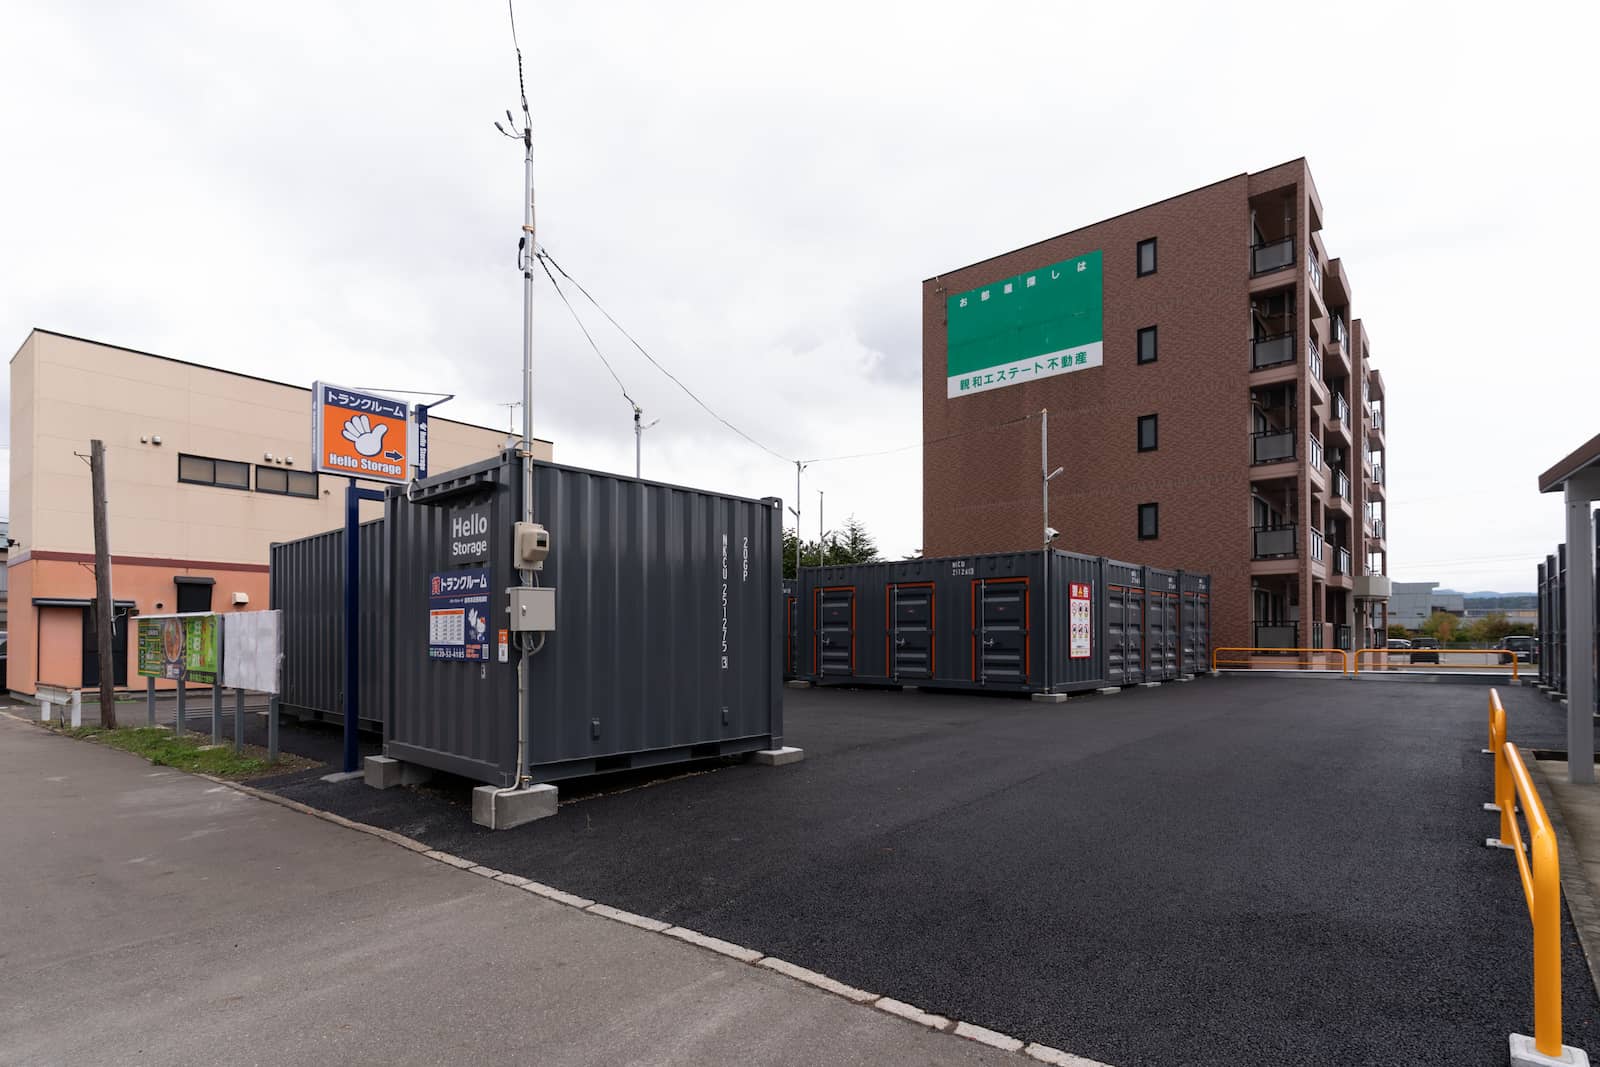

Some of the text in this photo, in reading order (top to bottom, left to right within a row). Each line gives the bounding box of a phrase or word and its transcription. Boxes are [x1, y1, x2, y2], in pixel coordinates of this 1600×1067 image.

[328, 391, 404, 418] トランクルーム
[328, 453, 402, 475] Hello Storage
[452, 512, 487, 538] Hello
[452, 540, 487, 556] Storage
[721, 656, 728, 669] 3
